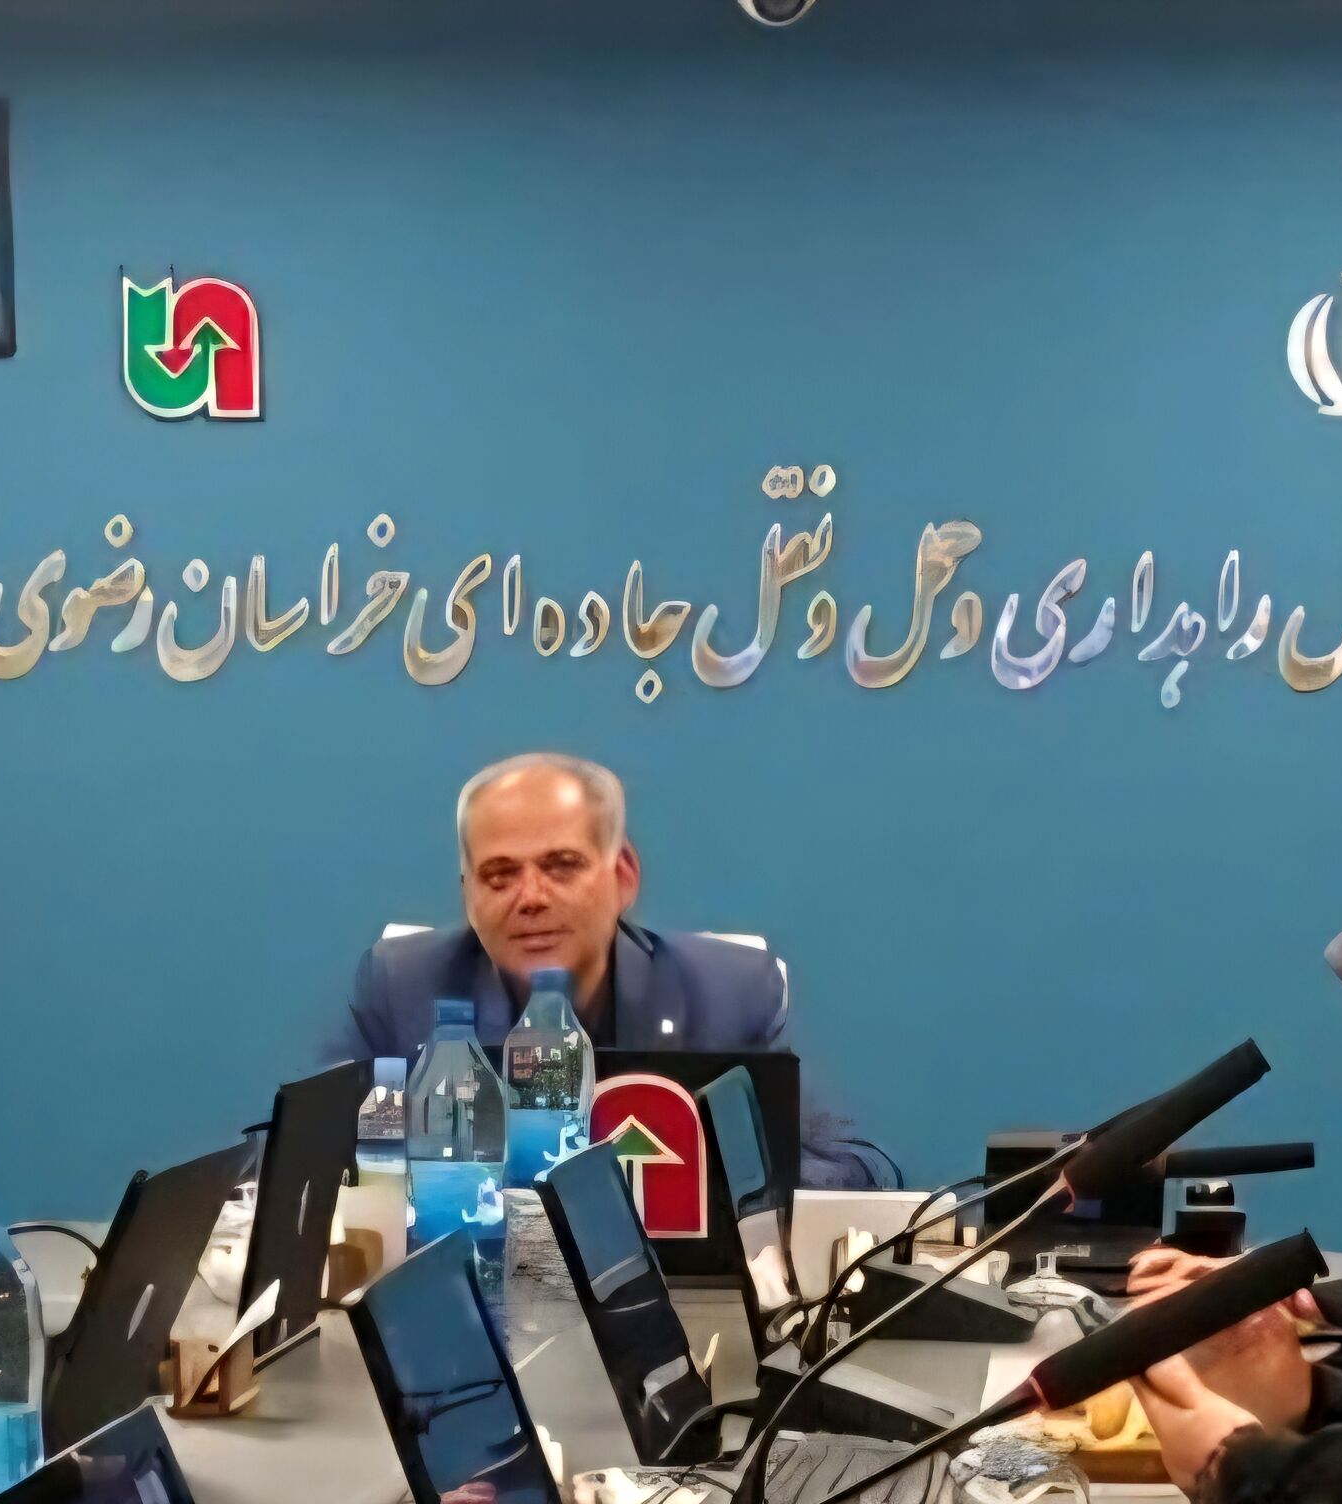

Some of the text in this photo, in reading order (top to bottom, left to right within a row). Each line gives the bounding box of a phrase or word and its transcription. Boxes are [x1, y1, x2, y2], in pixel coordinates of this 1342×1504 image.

[157, 513, 410, 682] خراسان
[692, 464, 837, 688] نقل
[797, 590, 838, 660] و
[991, 550, 1271, 709] راهداری
